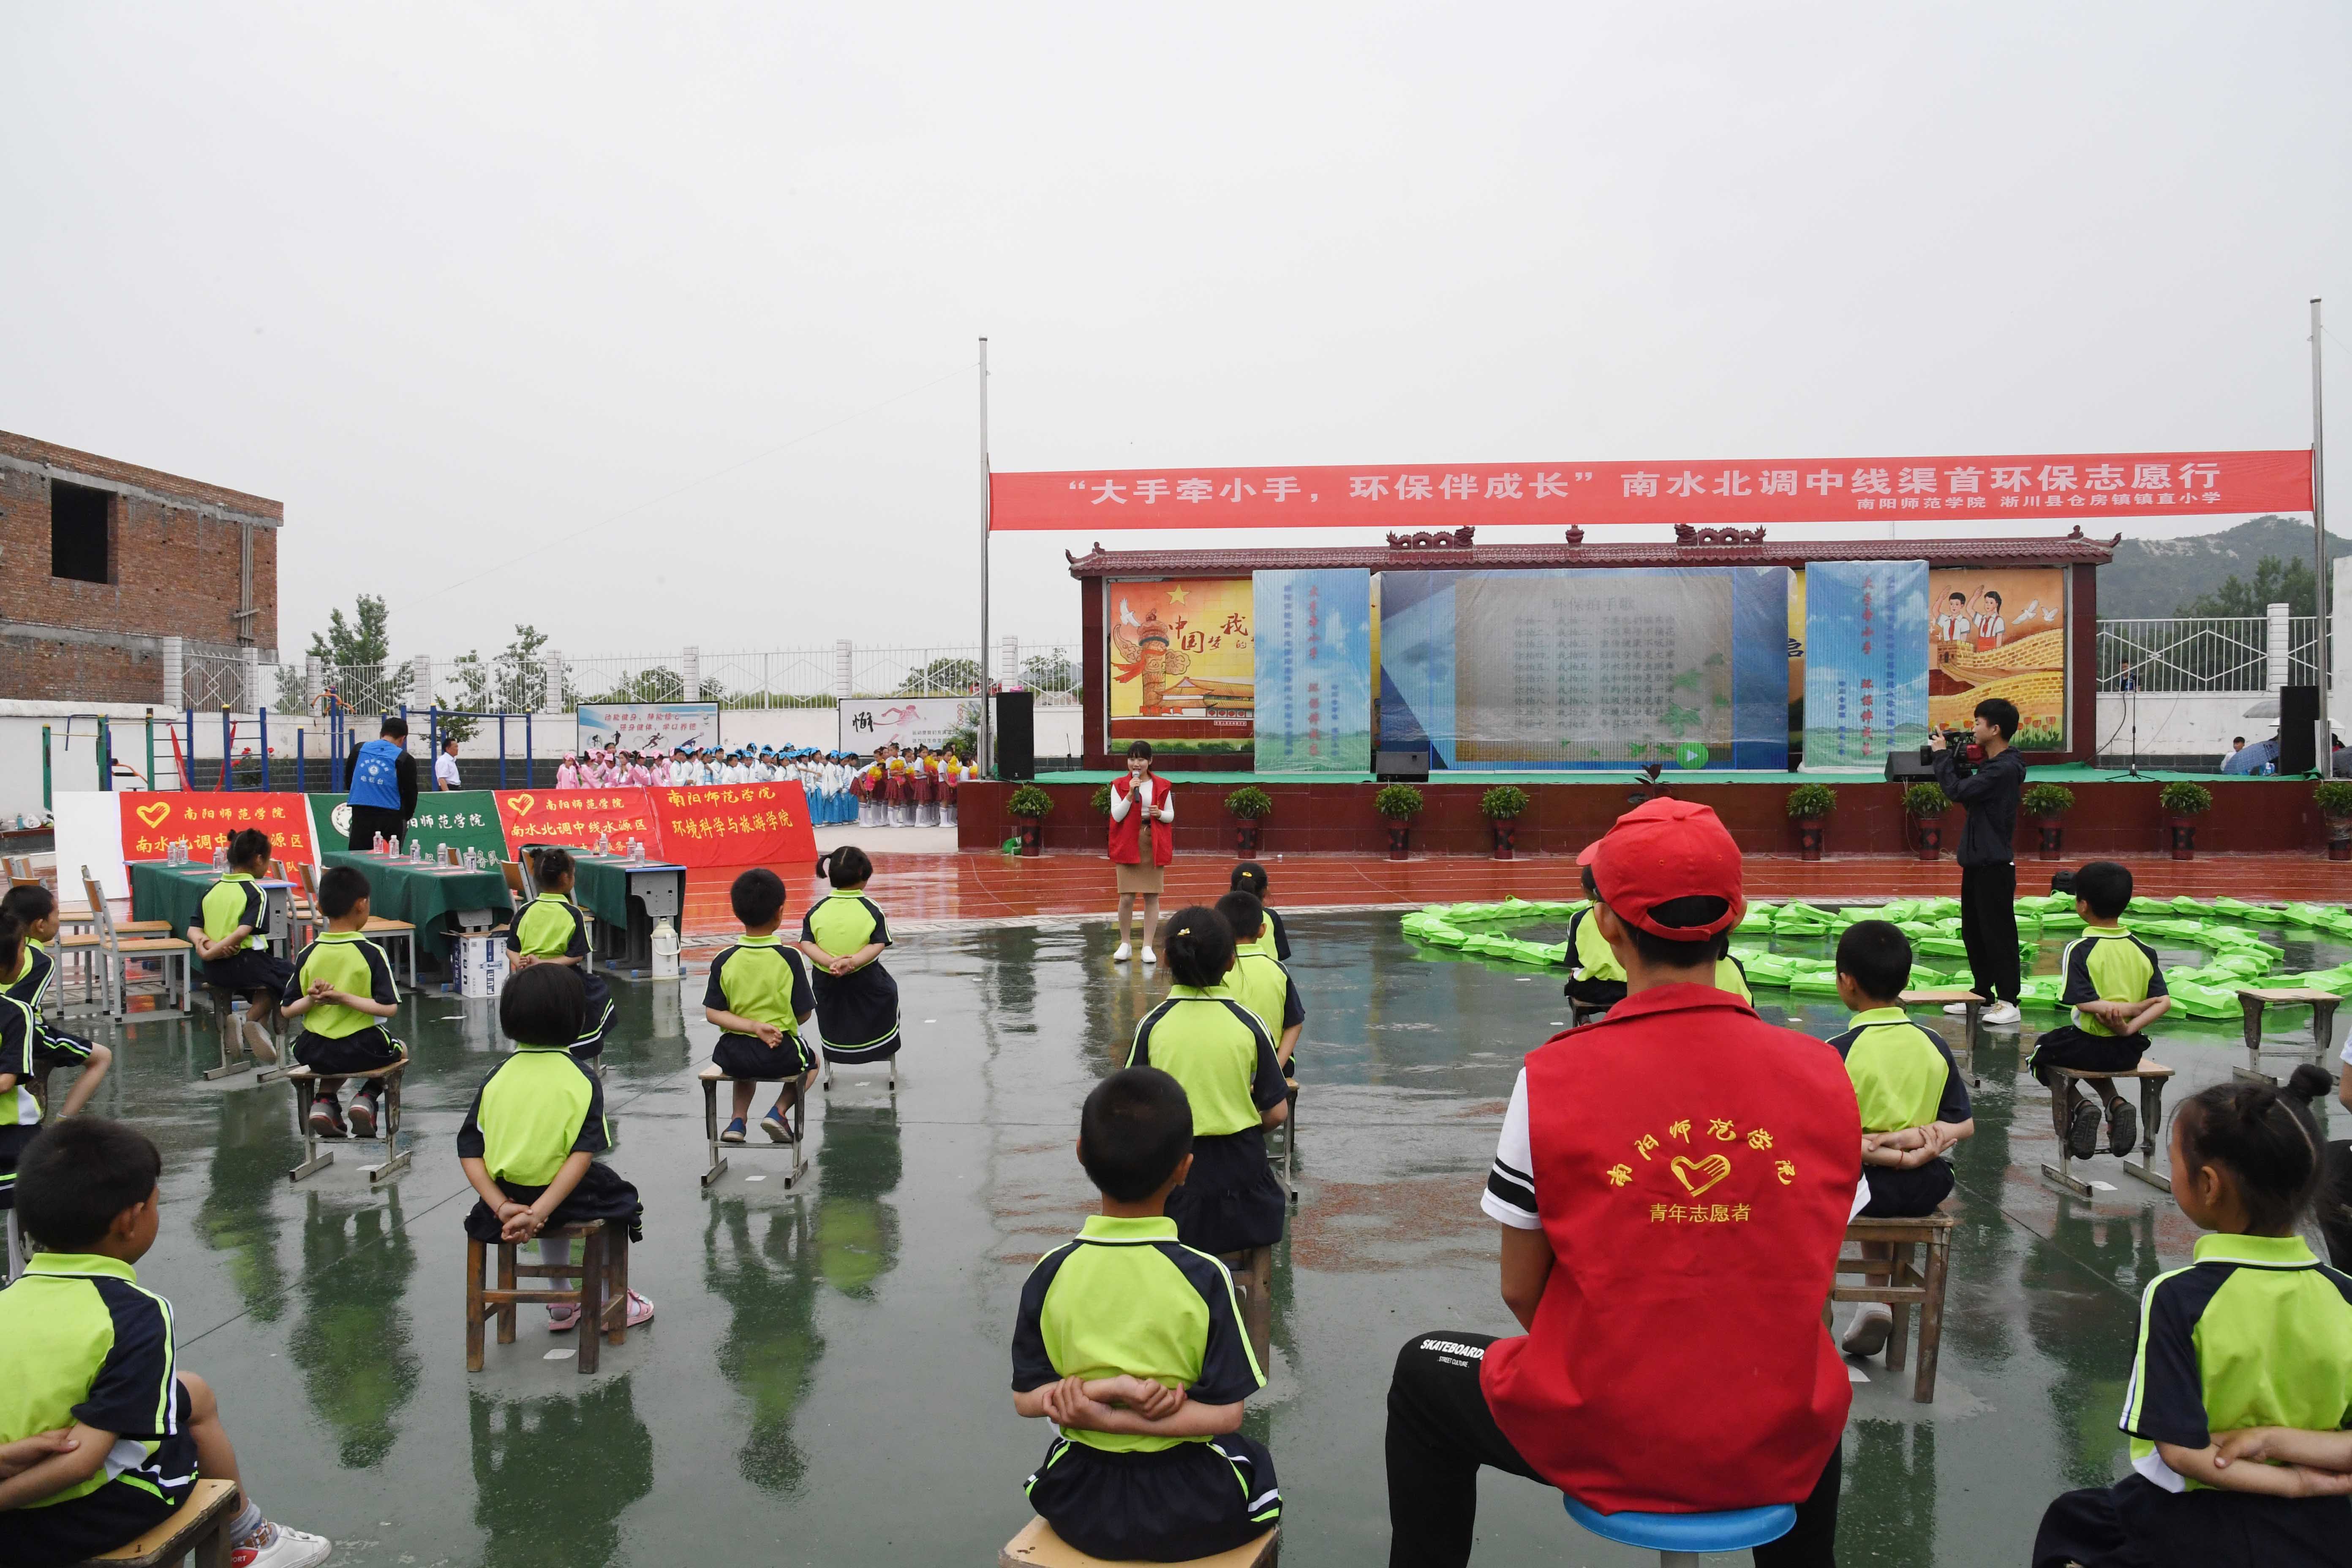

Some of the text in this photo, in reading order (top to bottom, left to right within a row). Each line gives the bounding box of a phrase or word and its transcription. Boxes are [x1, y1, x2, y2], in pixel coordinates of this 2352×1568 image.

[1857, 492, 2221, 510] 南阳师范学院 淅川县仓房镇镇直小学
[1168, 615, 1221, 653] 中国梦
[1220, 612, 1254, 649] 我的
[546, 798, 624, 811] 南阳师范学院
[667, 786, 776, 808] 南阳师范学院
[184, 807, 286, 821] 南阳师范学院
[407, 813, 485, 829] 阳师范学院
[672, 808, 793, 839] 环境科学与旅游学院
[511, 819, 647, 837] 南水北调中线水源区
[136, 832, 304, 853] 南水北调中源区
[1649, 1202, 1751, 1223] 青年志愿者
[1420, 1339, 1485, 1361] SKATEBOARD
[1439, 1356, 1469, 1368] STREET CULTURE
